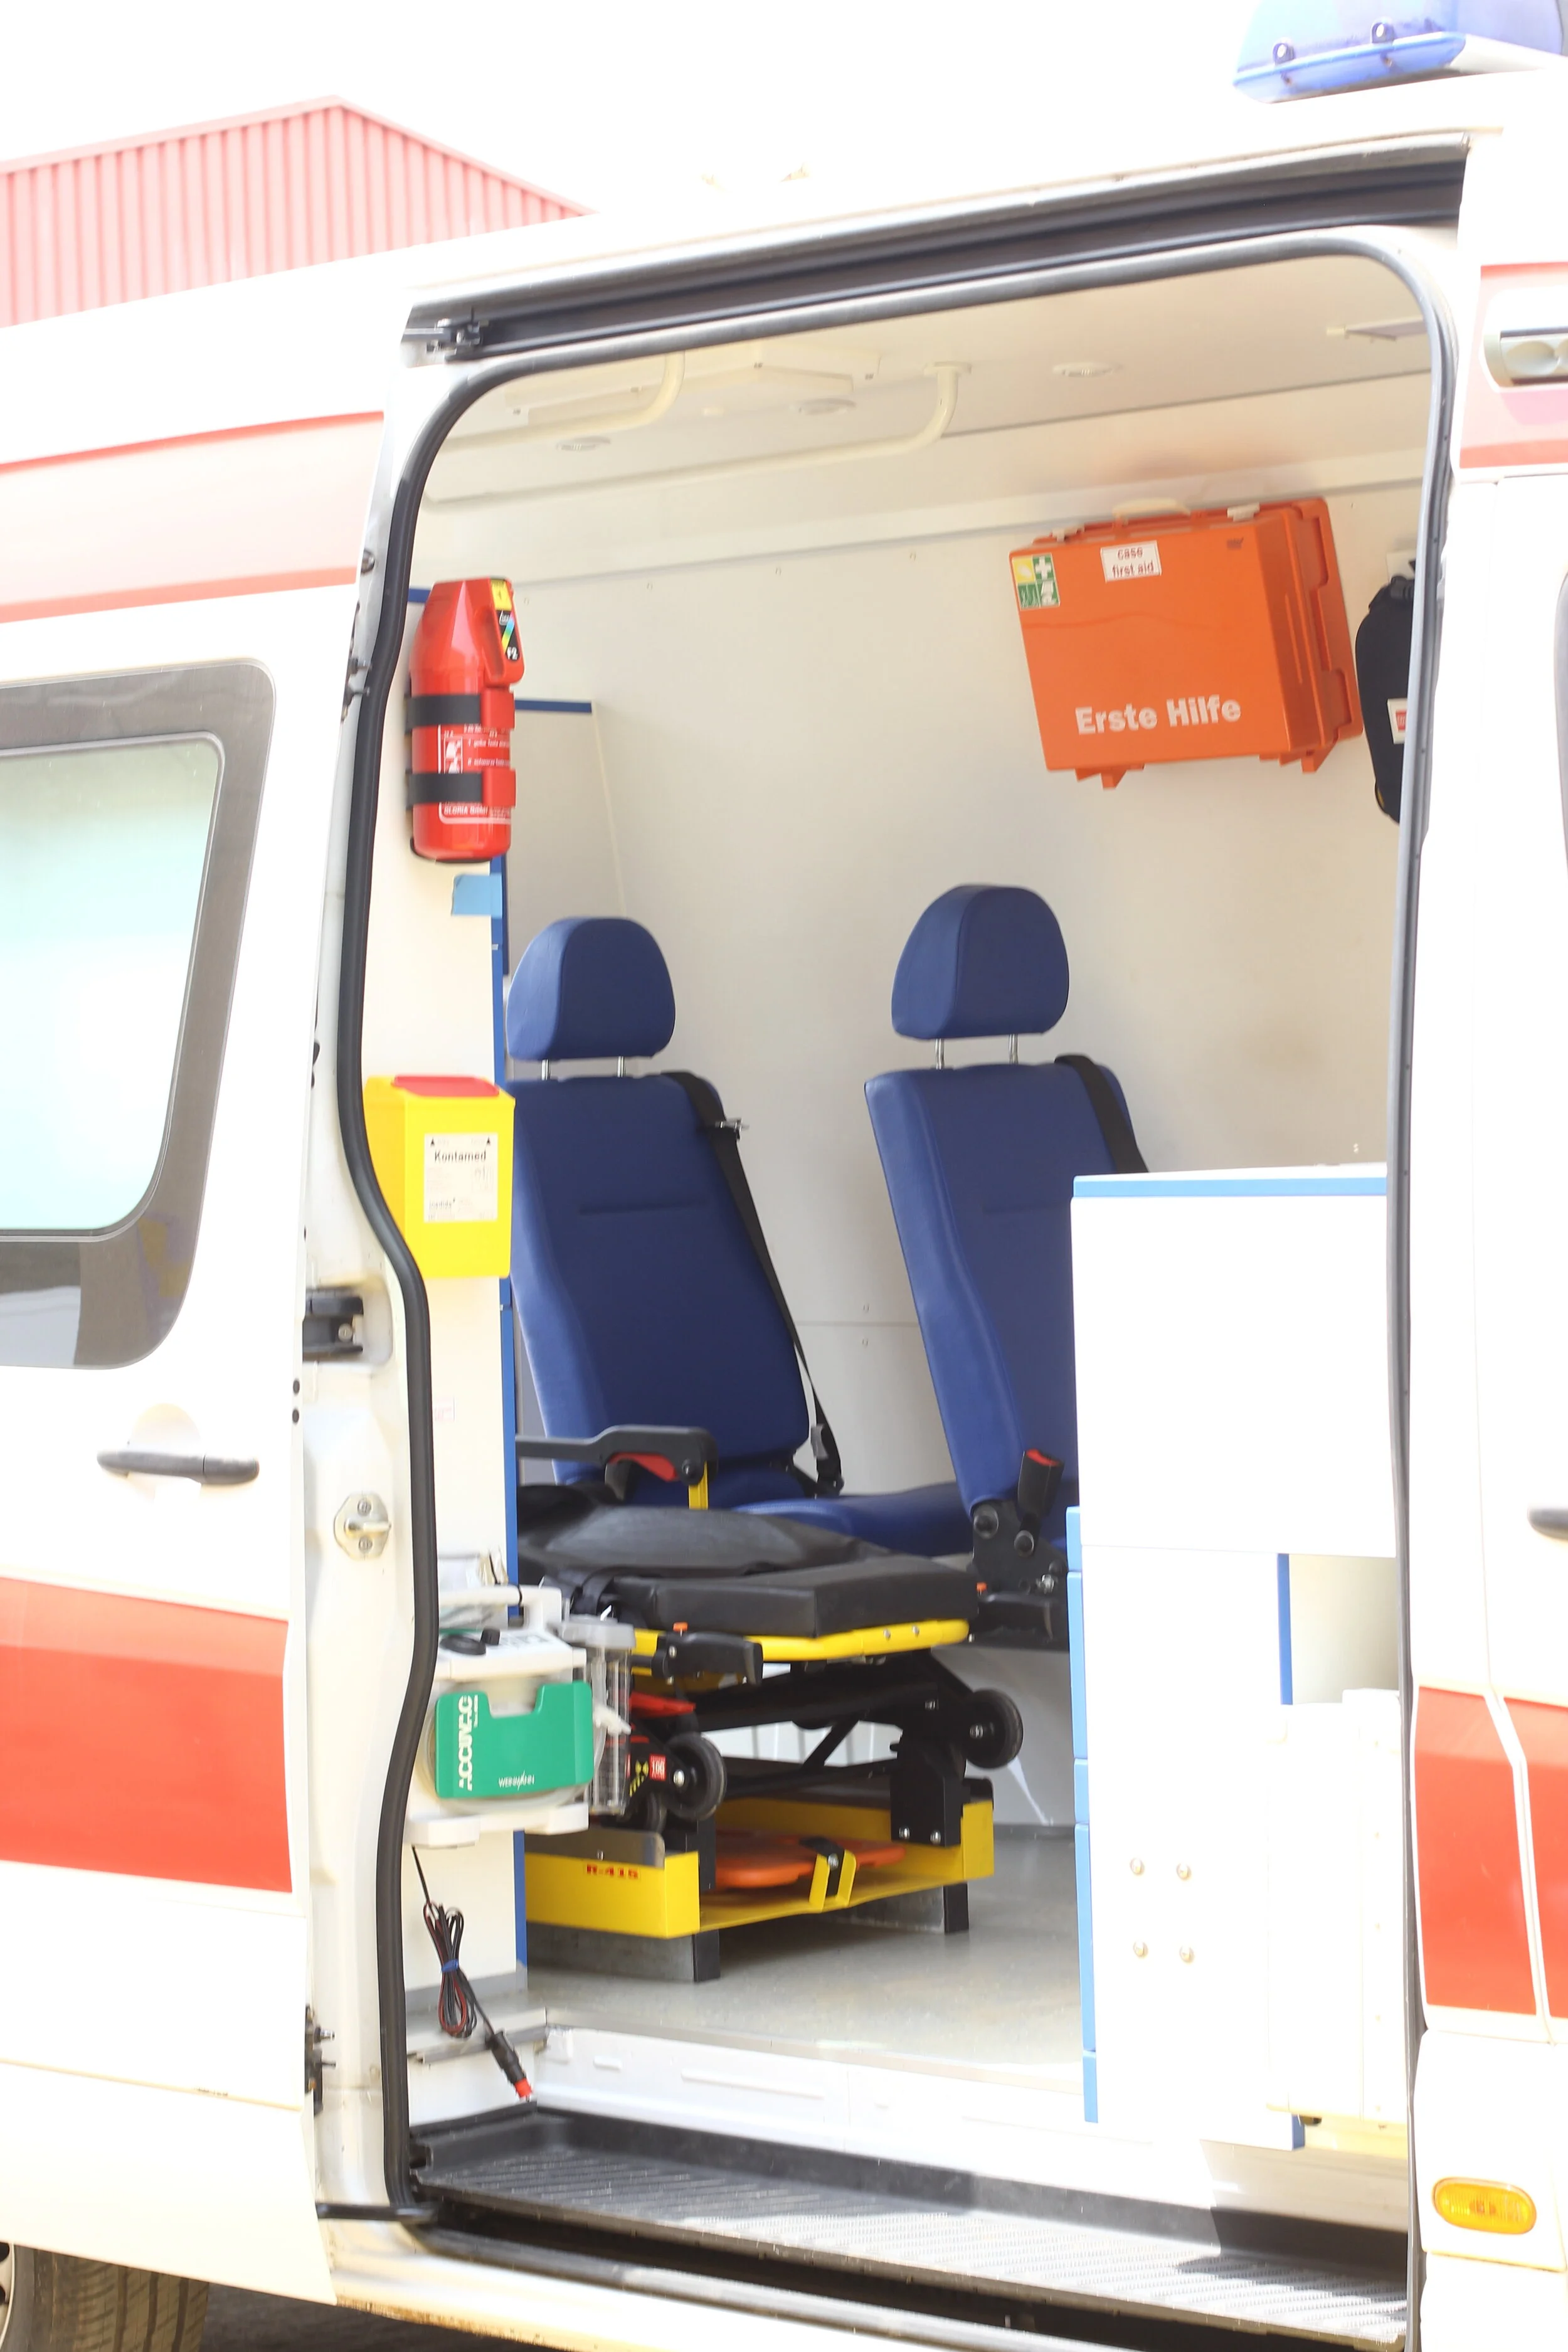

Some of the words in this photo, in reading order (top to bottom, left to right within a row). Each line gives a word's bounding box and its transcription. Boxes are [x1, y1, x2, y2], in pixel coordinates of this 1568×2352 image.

[1117, 546, 1143, 560] case
[1112, 563, 1134, 578] first
[1138, 560, 1154, 575] aid
[1075, 703, 1157, 734] Erste
[1166, 694, 1242, 728] Hilfe
[434, 1149, 487, 1163] Kontamed
